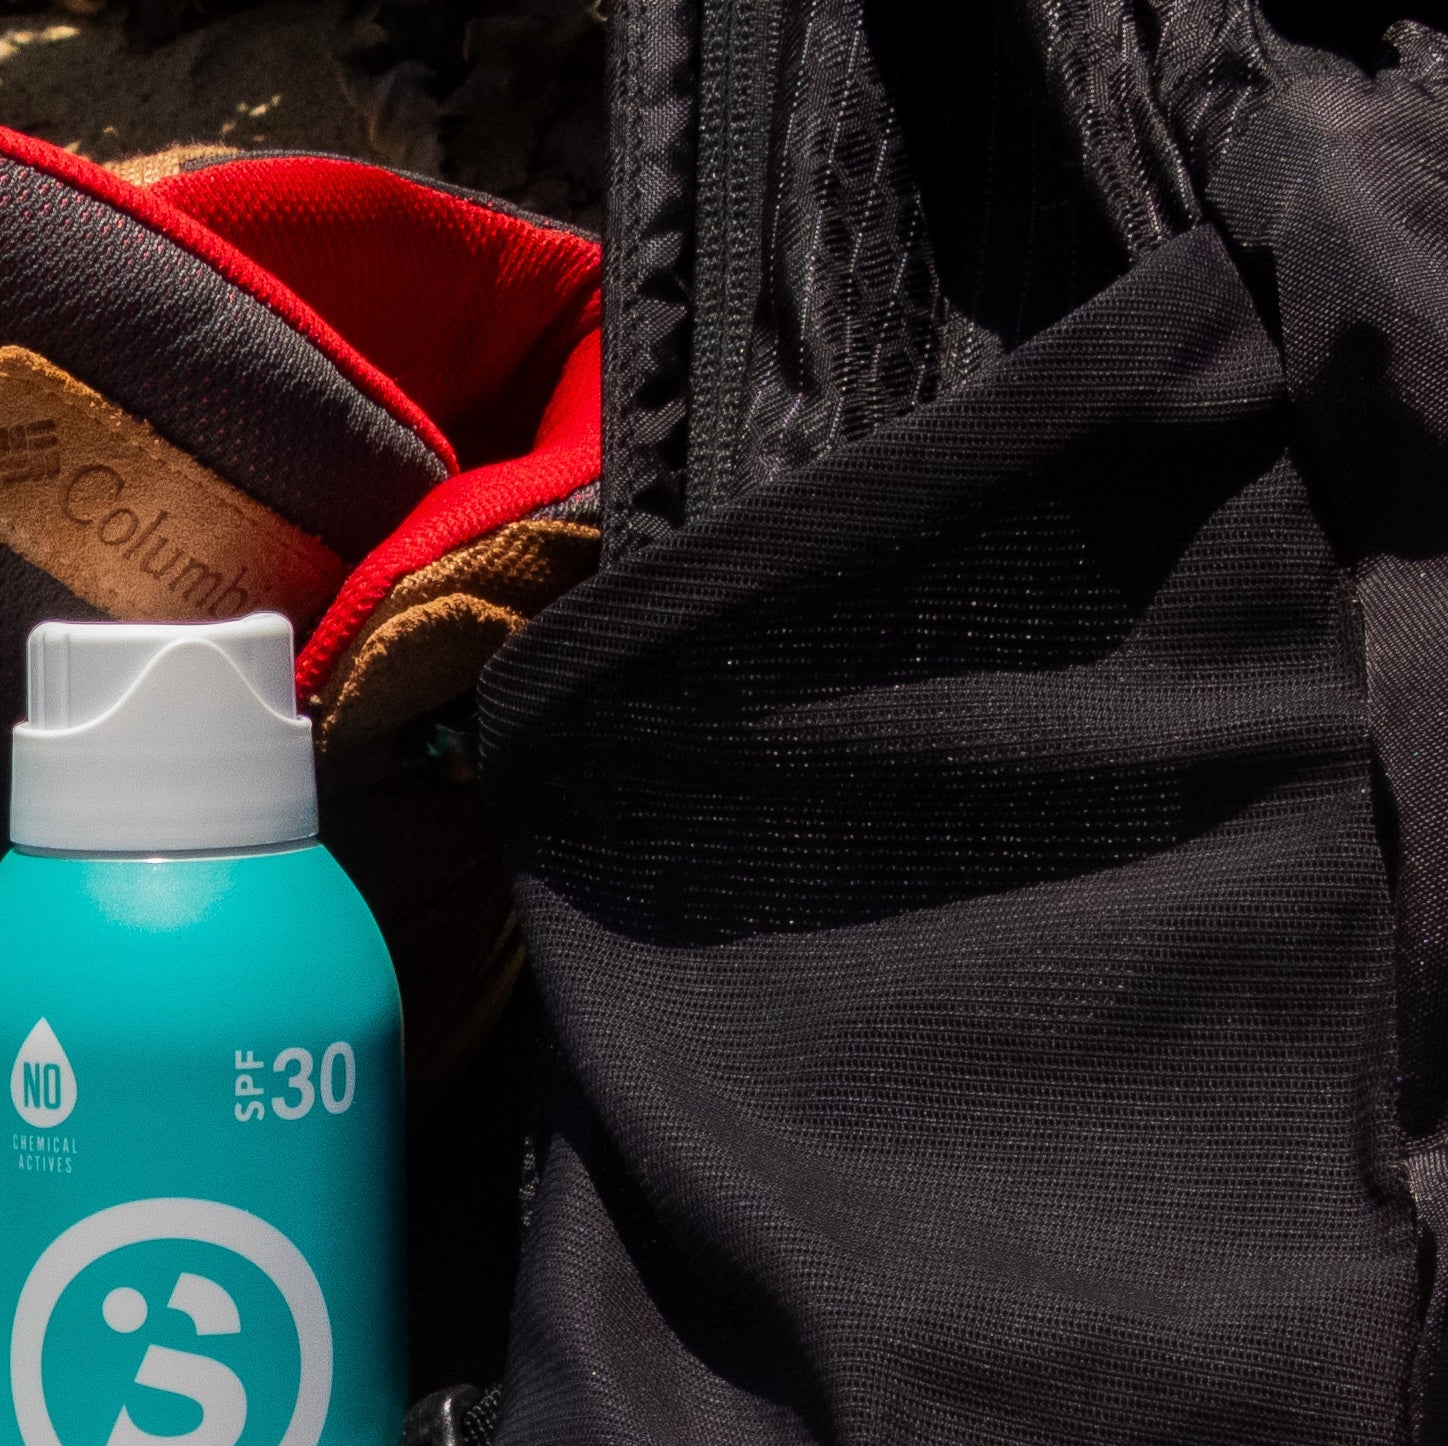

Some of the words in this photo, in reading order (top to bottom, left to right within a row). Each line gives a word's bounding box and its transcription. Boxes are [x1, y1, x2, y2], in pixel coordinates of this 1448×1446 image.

[61, 463, 250, 618] Columb
[23, 1062, 61, 1110] NO
[234, 1050, 264, 1122] SPF
[271, 1041, 356, 1120] 30
[12, 1133, 78, 1154] CHEMICAL
[18, 1153, 72, 1174] ACTIVES
